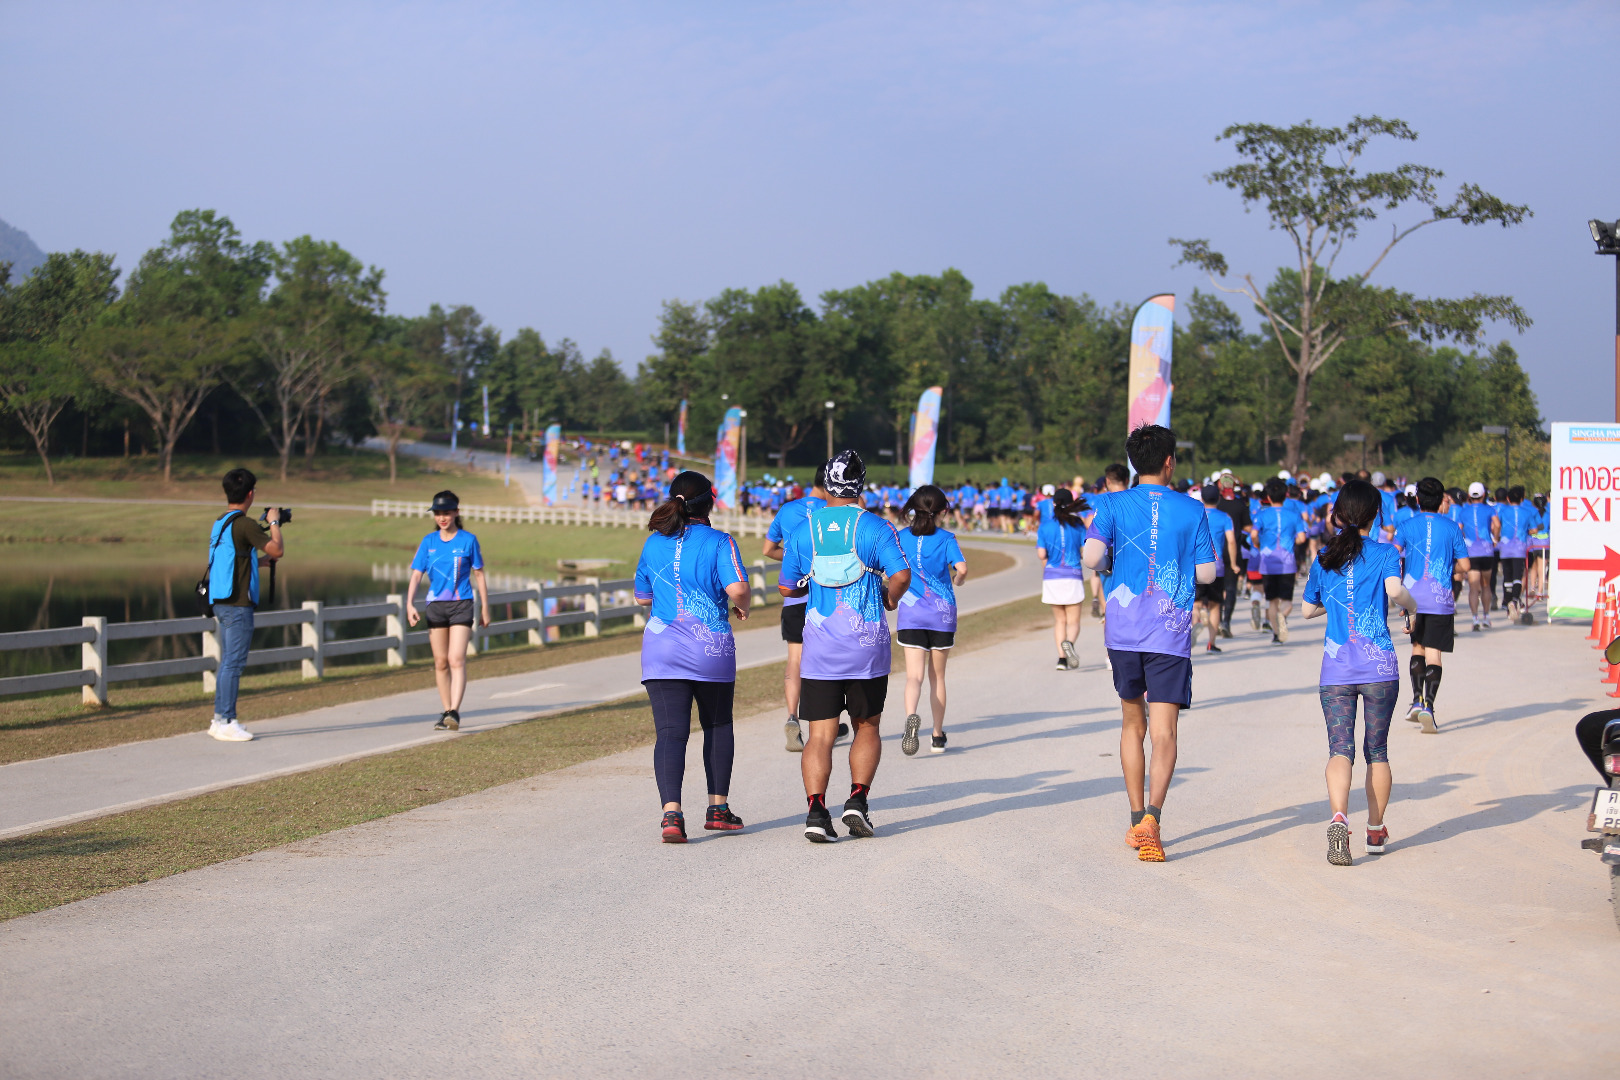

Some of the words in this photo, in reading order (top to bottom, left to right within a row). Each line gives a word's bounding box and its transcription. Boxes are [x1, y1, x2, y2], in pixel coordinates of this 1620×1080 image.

[1571, 429, 1604, 437] SINGHA
[1606, 429, 1620, 438] PAR
[1559, 466, 1620, 491] ทางออ
[1150, 528, 1158, 551] BEAT
[673, 561, 681, 582] BEAT
[1146, 552, 1156, 596] YOURSELF
[835, 587, 843, 616] RSELF
[1346, 579, 1354, 600] BEAT
[675, 583, 684, 622] YOURSELF
[1347, 601, 1357, 643] YOURSELF
